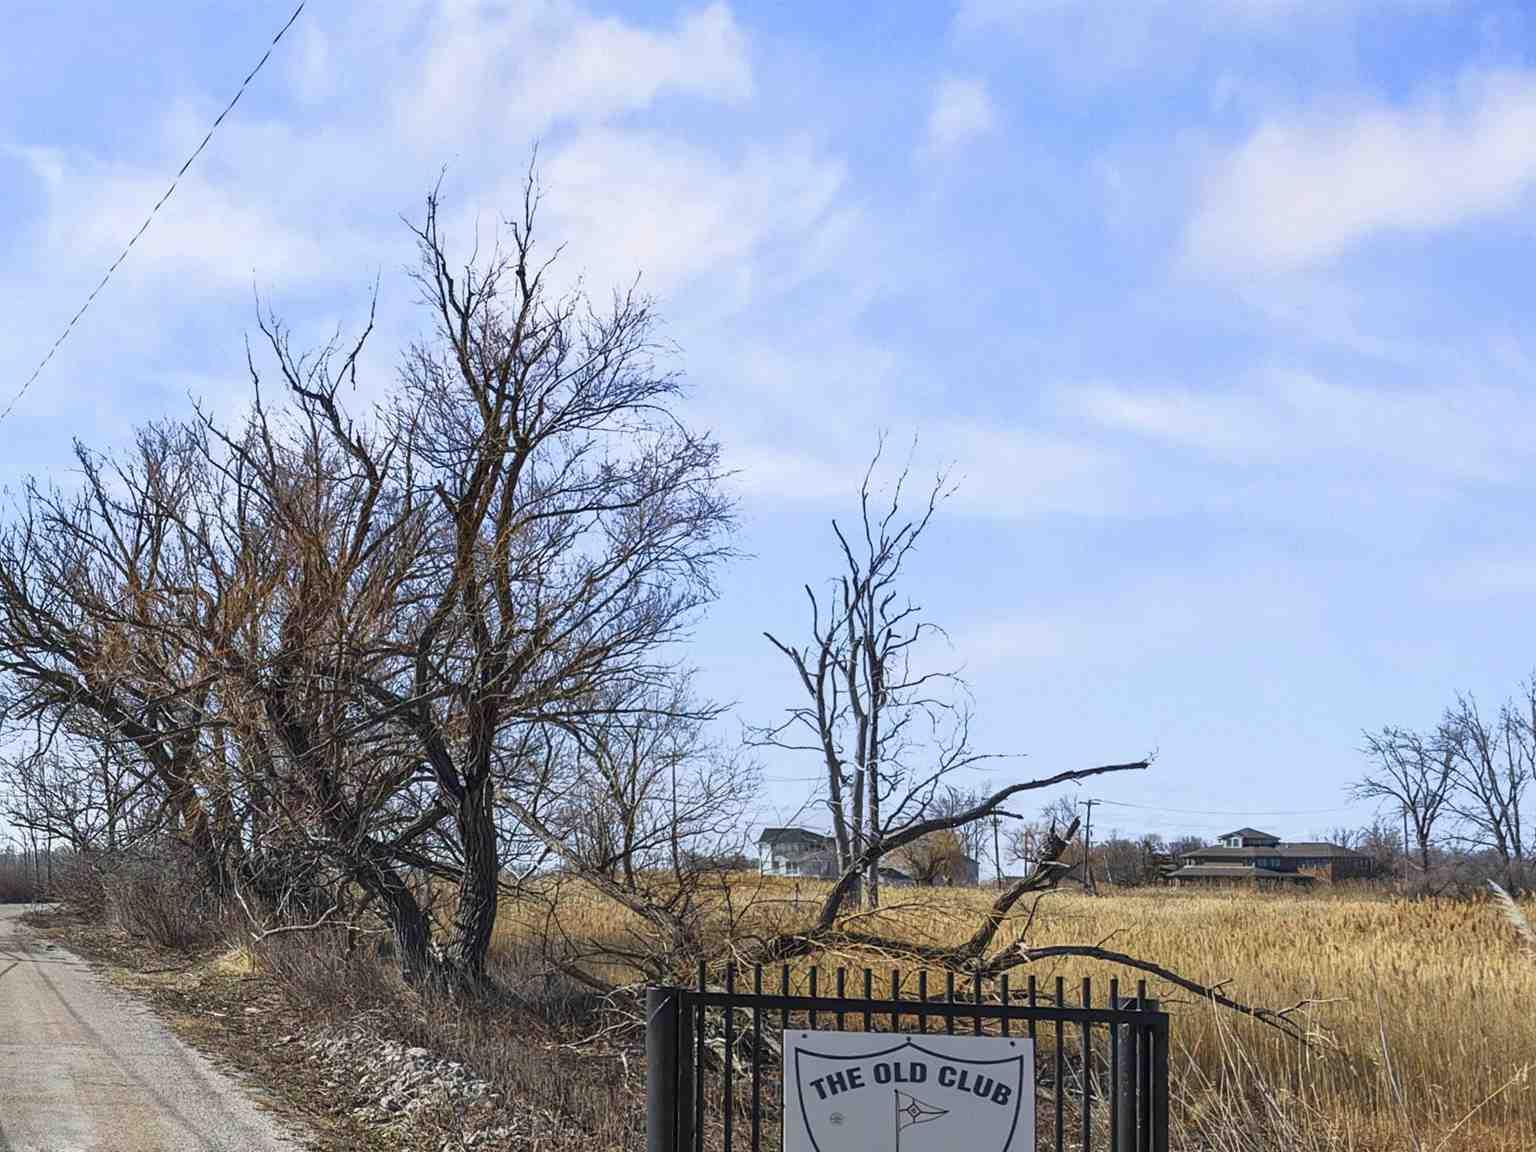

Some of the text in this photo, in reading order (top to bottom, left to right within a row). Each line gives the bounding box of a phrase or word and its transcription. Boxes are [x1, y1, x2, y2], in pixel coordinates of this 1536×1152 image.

[809, 1062, 1013, 1106] THE OLD CLUB
